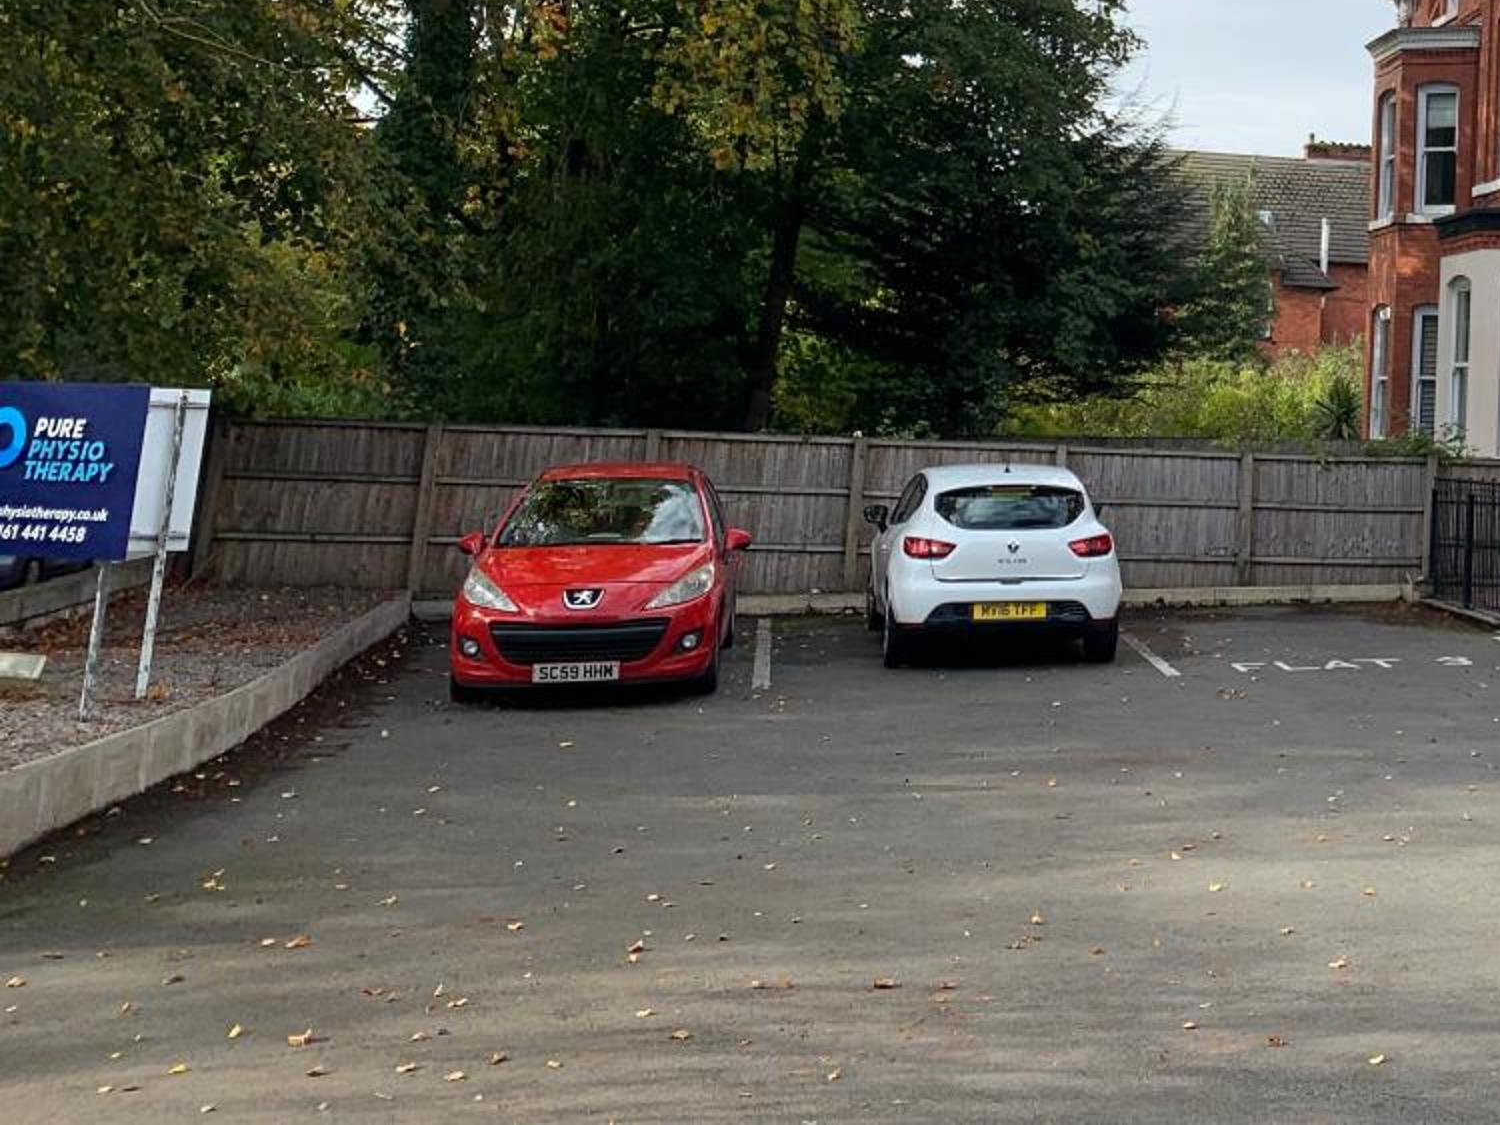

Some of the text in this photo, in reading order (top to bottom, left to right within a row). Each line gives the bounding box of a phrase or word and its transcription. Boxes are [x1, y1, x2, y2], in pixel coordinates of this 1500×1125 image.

[34, 417, 87, 438] PURE
[27, 439, 105, 461] PHYSIO
[24, 460, 114, 483] THERAPY
[21, 524, 47, 541] 441
[48, 525, 87, 543] 4458
[539, 666, 579, 680] SC59
[1231, 657, 1401, 672] FLAT
